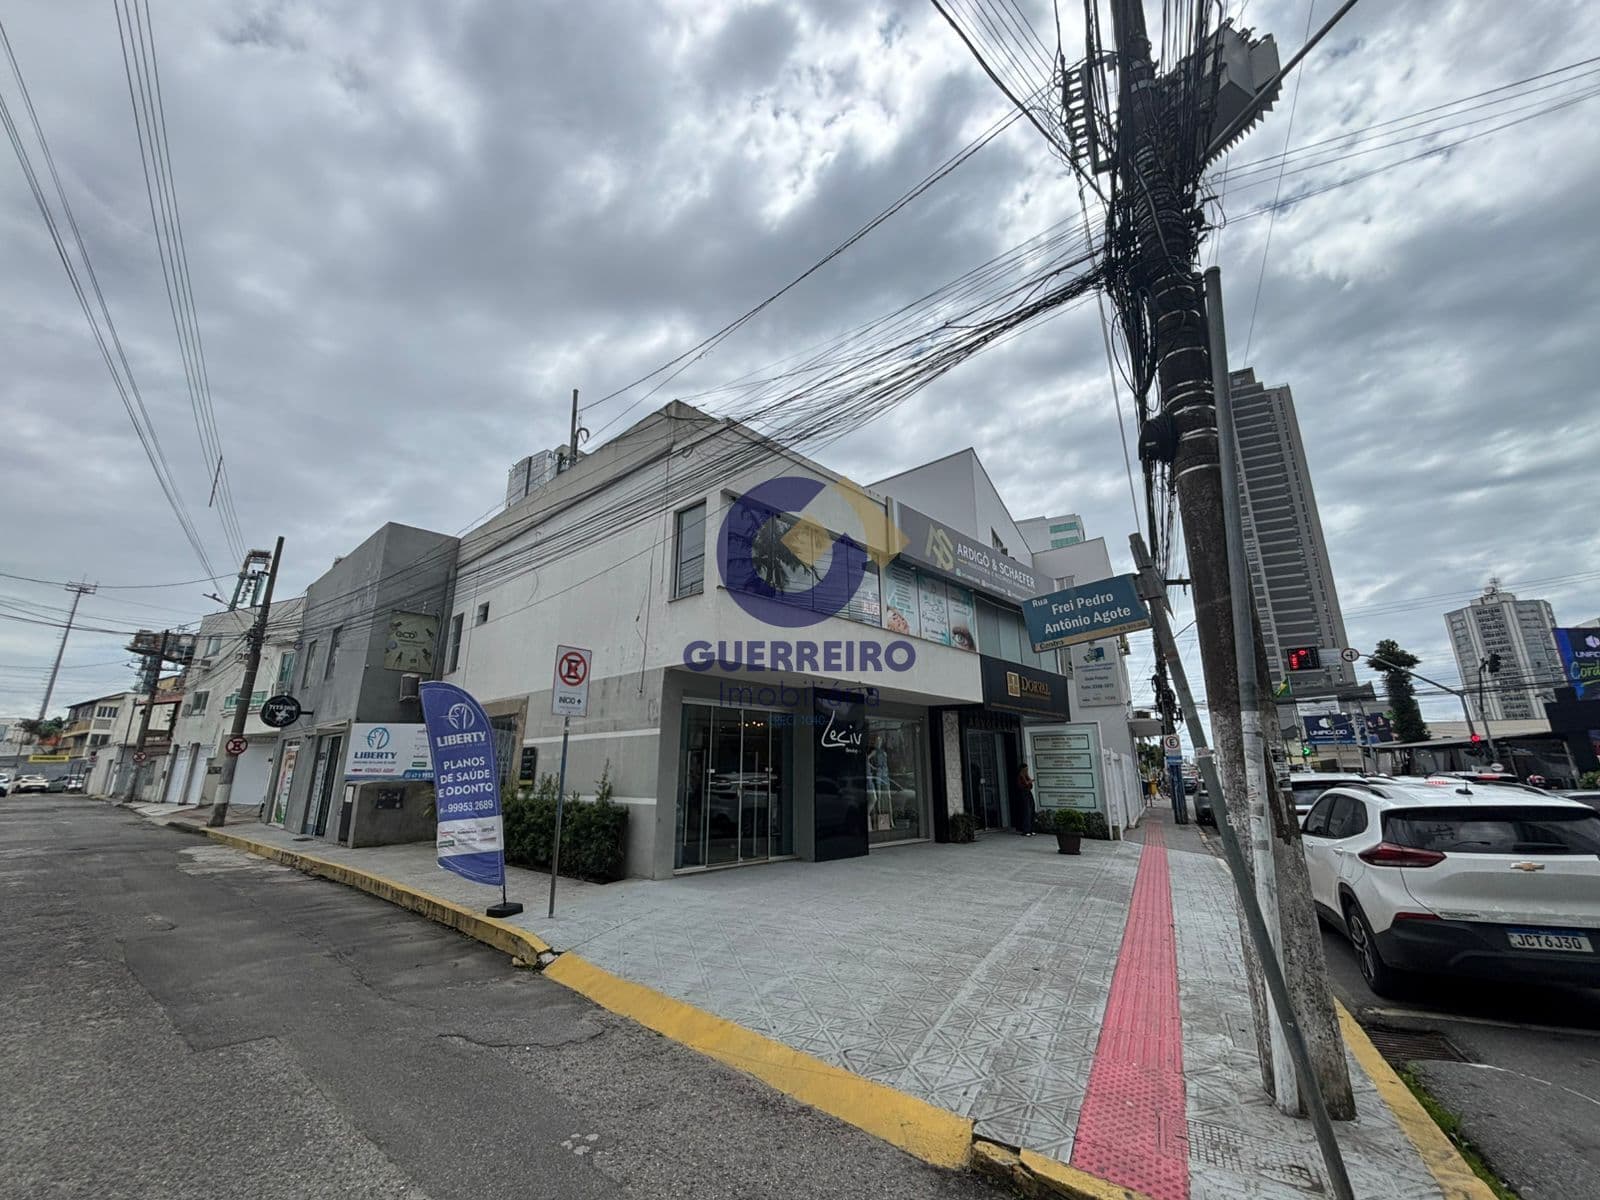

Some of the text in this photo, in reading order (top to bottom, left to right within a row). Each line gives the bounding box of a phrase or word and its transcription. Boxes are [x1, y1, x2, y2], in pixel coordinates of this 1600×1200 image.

[999, 562, 1036, 589] SCHAEFER
[1031, 598, 1048, 608] Rua
[1051, 591, 1114, 616] Frei Pedro
[1045, 614, 1091, 634] Antônio
[1093, 606, 1131, 624] Agote
[436, 731, 486, 747] LIBERTY
[354, 751, 398, 760] LIBERTY
[443, 756, 485, 770] PLANOS
[440, 768, 490, 784] DE SAÚDE
[438, 782, 494, 798] E ODONTO
[1517, 934, 1582, 950] JCT6J30
